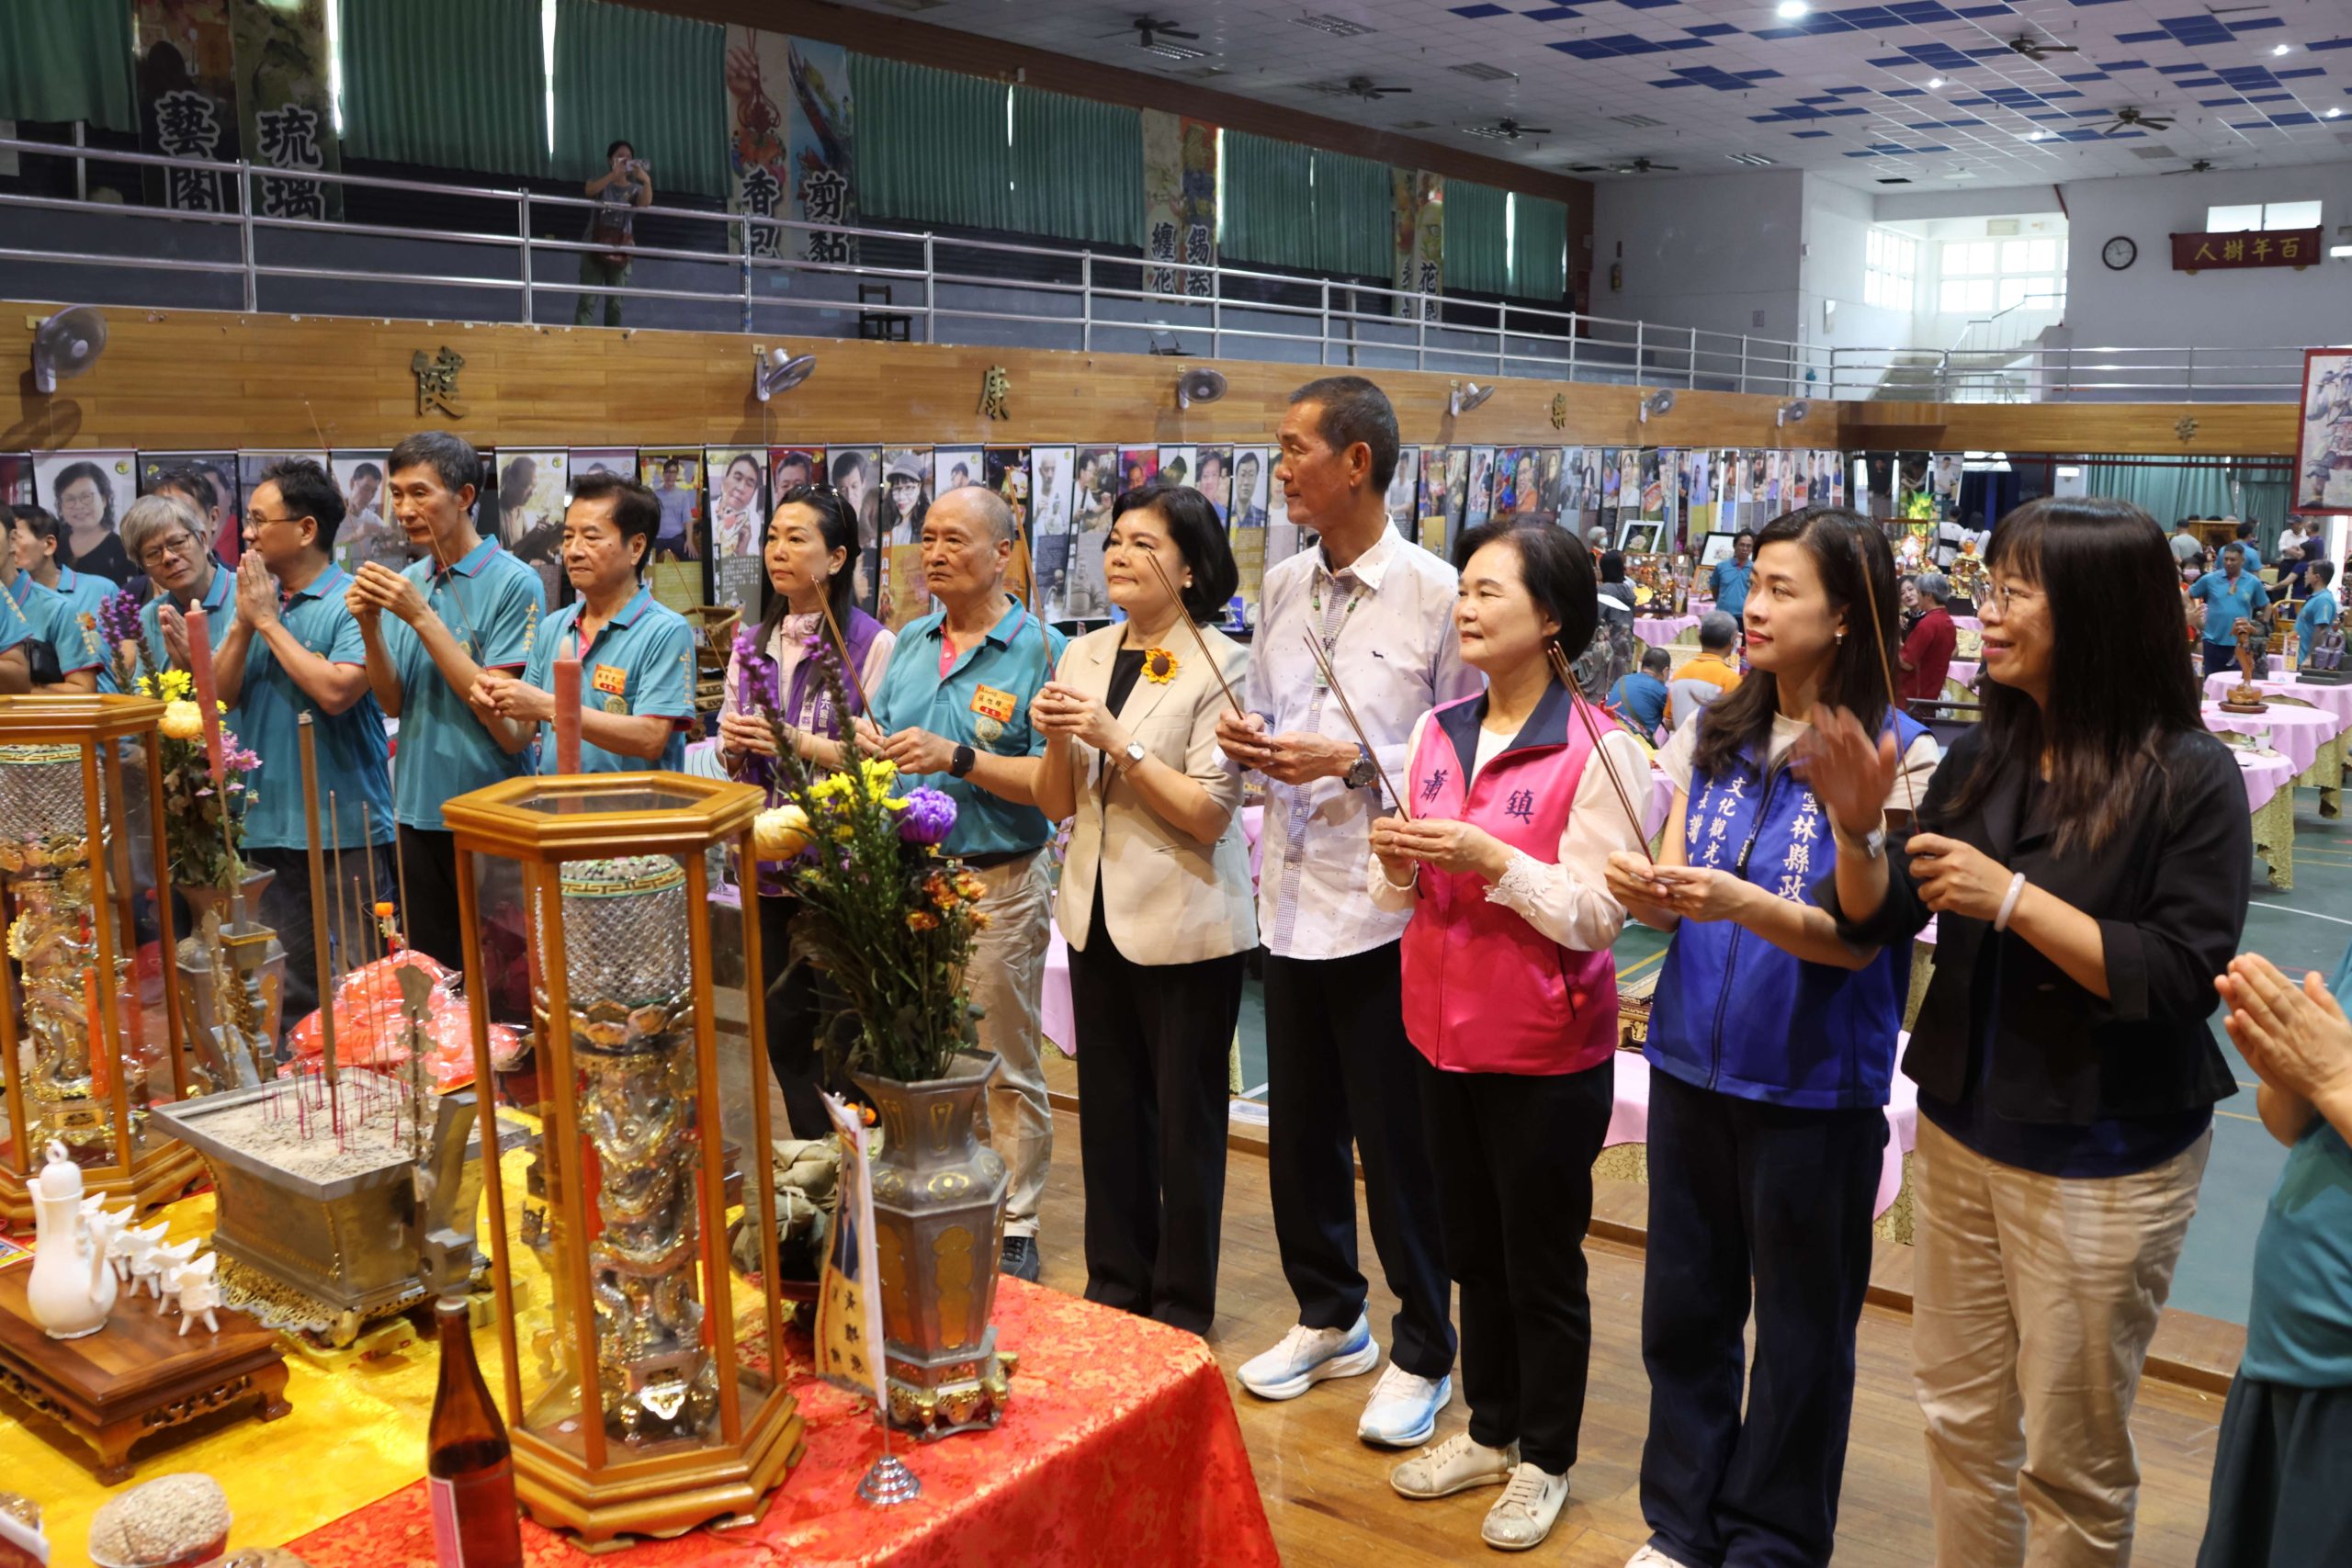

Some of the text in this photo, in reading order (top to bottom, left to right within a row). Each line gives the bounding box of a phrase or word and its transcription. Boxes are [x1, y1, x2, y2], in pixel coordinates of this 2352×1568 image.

[156, 93, 223, 219] 藝閣
[258, 106, 324, 221] 琉璃
[2194, 237, 2301, 262] 百年樹人
[976, 365, 1011, 421] 康
[1505, 789, 1534, 825] 鎮
[1702, 776, 1747, 869] 文化觀光
[1778, 792, 1819, 906] 雲林縣政
